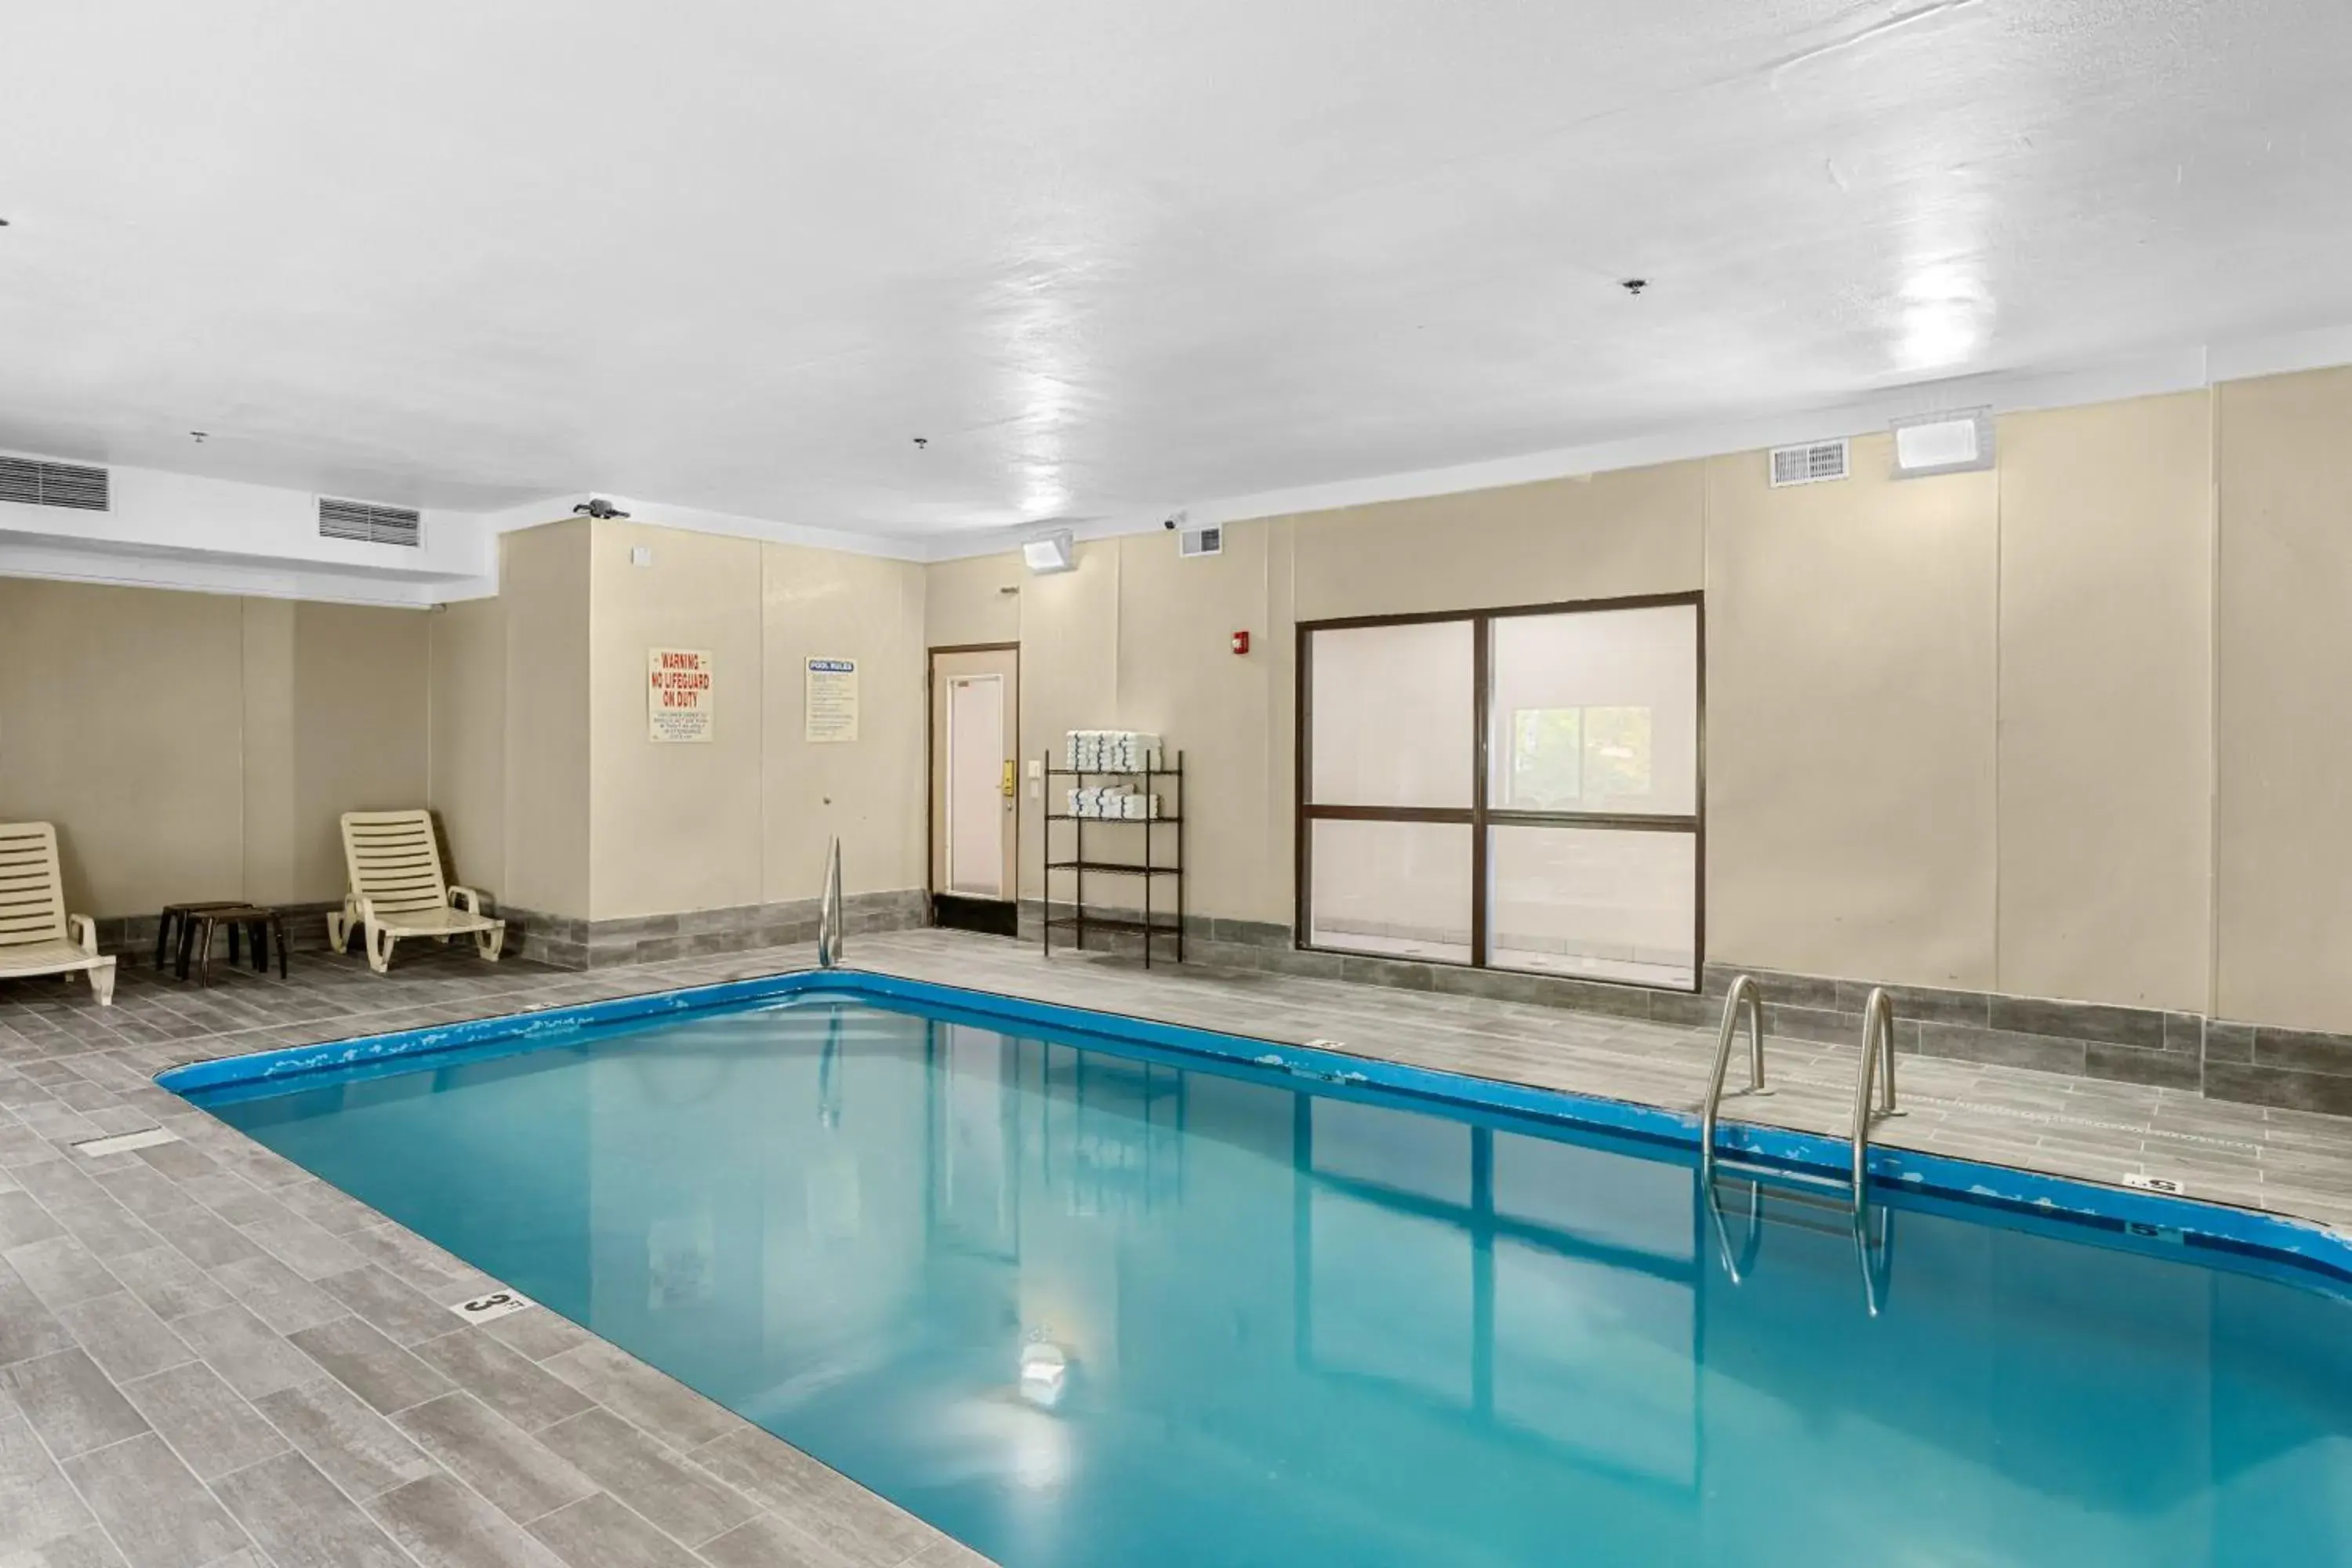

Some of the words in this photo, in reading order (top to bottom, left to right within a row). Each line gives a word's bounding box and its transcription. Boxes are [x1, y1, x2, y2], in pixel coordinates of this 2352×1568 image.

[662, 652, 698, 670] WARNING
[810, 662, 829, 670] POOL
[652, 672, 662, 688] NO
[664, 672, 709, 690] LIFEGUARD
[663, 691, 675, 706] ON
[677, 691, 697, 708] DUTY
[464, 1294, 510, 1312] 3
